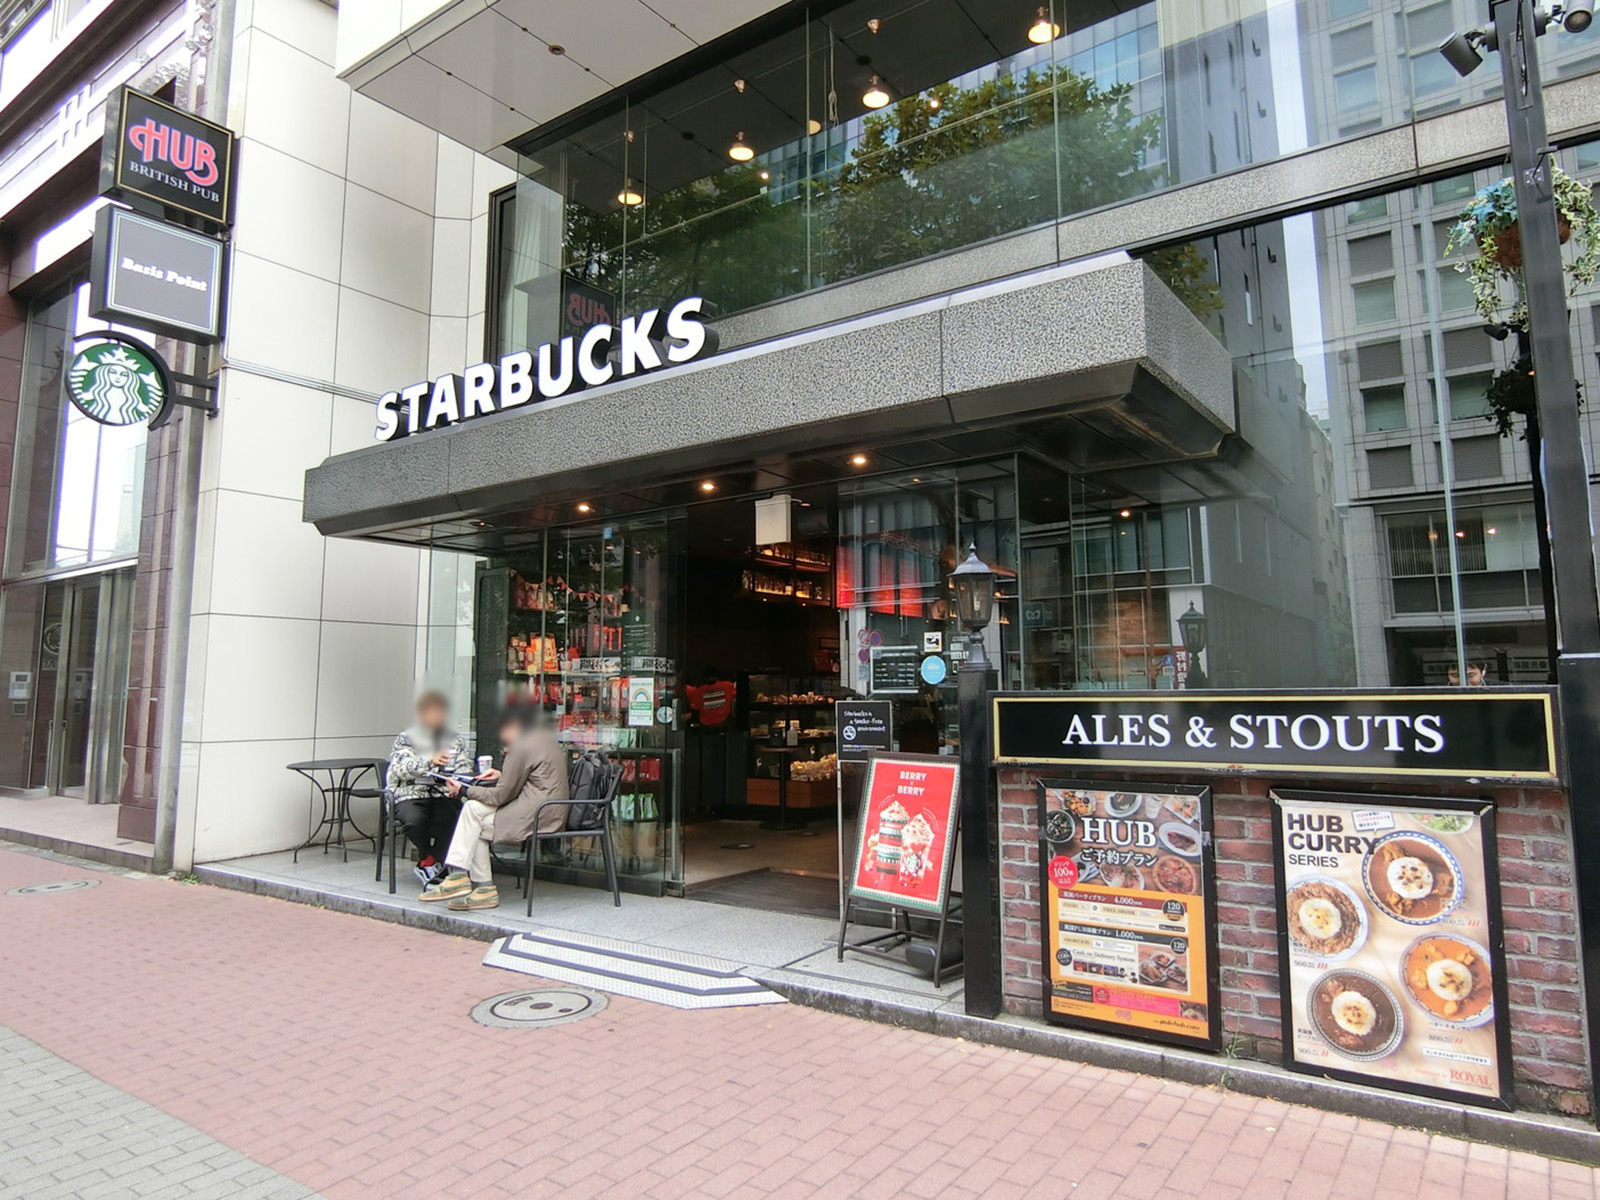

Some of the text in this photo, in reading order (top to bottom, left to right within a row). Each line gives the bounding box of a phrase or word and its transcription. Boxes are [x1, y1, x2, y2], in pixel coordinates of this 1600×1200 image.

[128, 117, 219, 187] HUB
[129, 160, 220, 203] BRITISH PUB
[121, 257, 208, 292] Basis Point
[374, 297, 707, 442] STARBUCKS
[1062, 714, 1446, 753] ALES & STOUTS
[899, 770, 927, 781] BERRY
[897, 784, 925, 796] BERRY
[1081, 817, 1157, 848] HUB
[1287, 813, 1343, 833] HUB
[1288, 832, 1380, 855] CURRY
[1081, 848, 1158, 867] ご予約プラン
[1288, 853, 1339, 868] SERIES
[1167, 901, 1181, 911] 120
[1173, 941, 1185, 949] 120
[1449, 1069, 1493, 1087] ROYAL
